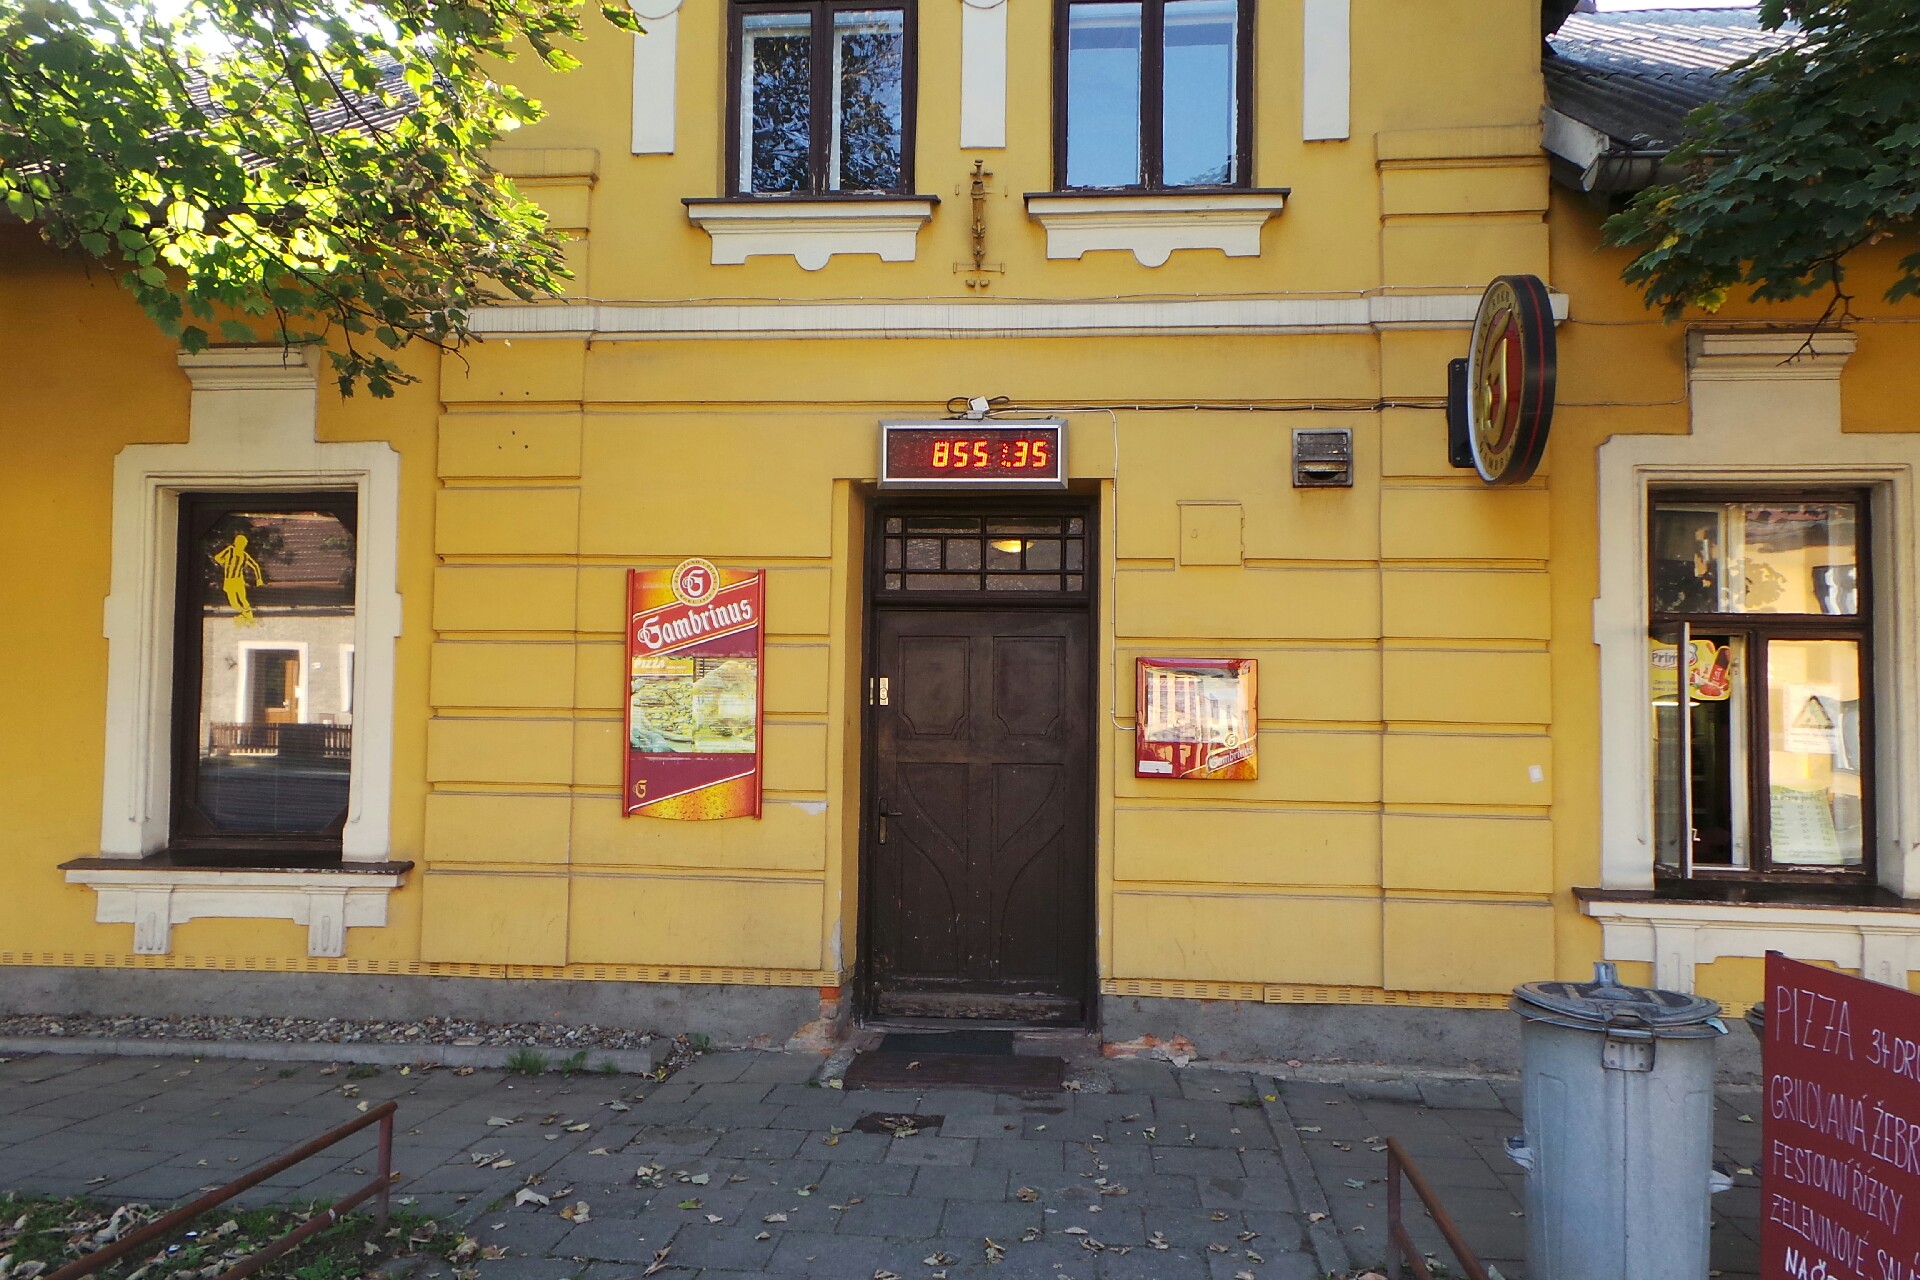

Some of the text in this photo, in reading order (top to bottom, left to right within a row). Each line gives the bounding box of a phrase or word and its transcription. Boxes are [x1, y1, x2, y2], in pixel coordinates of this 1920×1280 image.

[637, 599, 753, 650] Gambrinus
[1776, 985, 1854, 1060] PIZZA
[1771, 1074, 1868, 1152] GRILOVANÁ
[1773, 1139, 1903, 1235] FESTOVNÍ ŘÍZKY
[1770, 1193, 1870, 1276] ZELENINOVÉ
